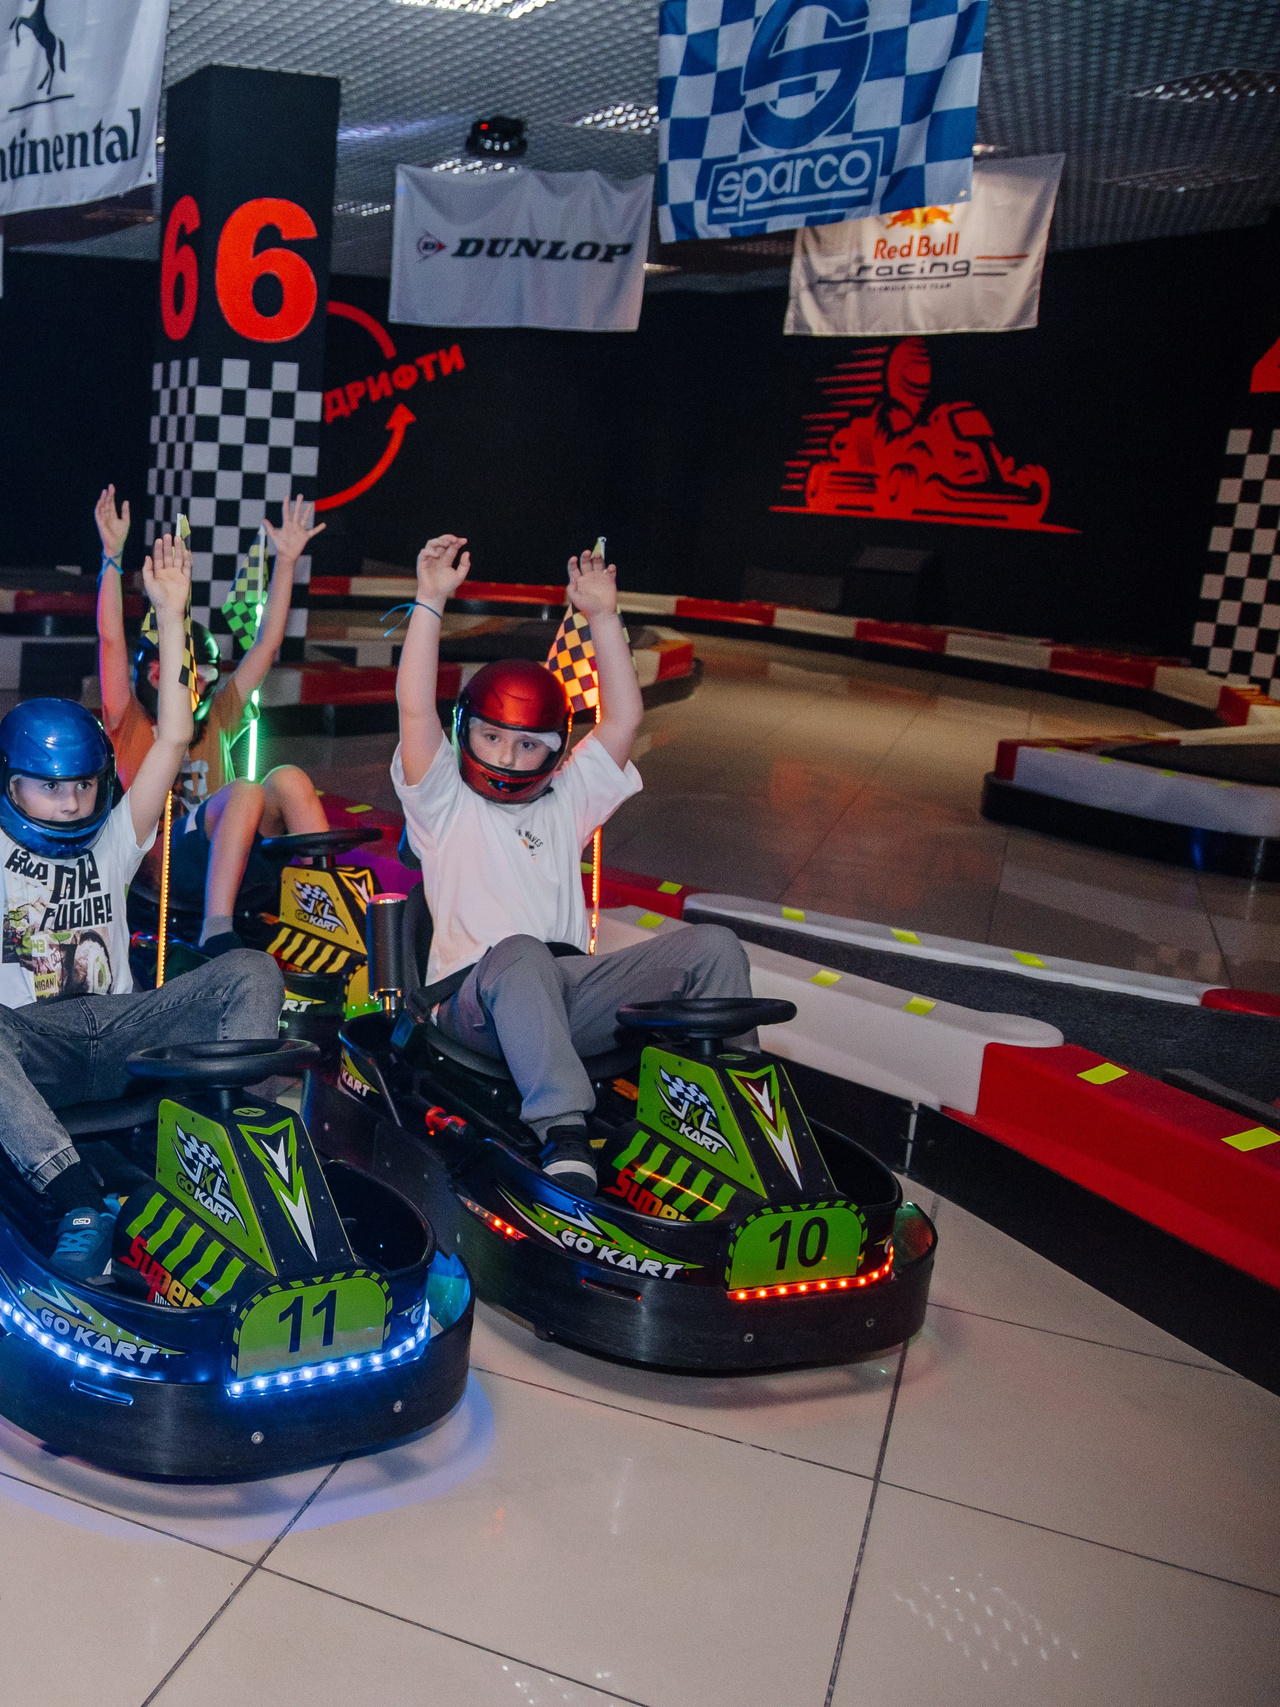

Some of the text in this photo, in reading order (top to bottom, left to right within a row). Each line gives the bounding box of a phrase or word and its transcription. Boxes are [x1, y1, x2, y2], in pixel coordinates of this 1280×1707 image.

[717, 149, 872, 217] sparco
[160, 195, 201, 341] 6
[215, 198, 318, 343] 6
[451, 237, 634, 263] DUNLOP
[855, 259, 971, 278] racing
[873, 233, 961, 260] Red Bull
[322, 344, 465, 424] ДРИФТИ
[309, 916, 339, 933] KART
[283, 999, 313, 1013] RT
[342, 1069, 371, 1097] KART
[660, 1110, 722, 1154] GO KART
[176, 1172, 235, 1224] GO KART
[560, 1229, 685, 1280] GO KART
[768, 1216, 829, 1271] 10
[40, 1308, 160, 1364] GO KART
[278, 1289, 337, 1353] 11
